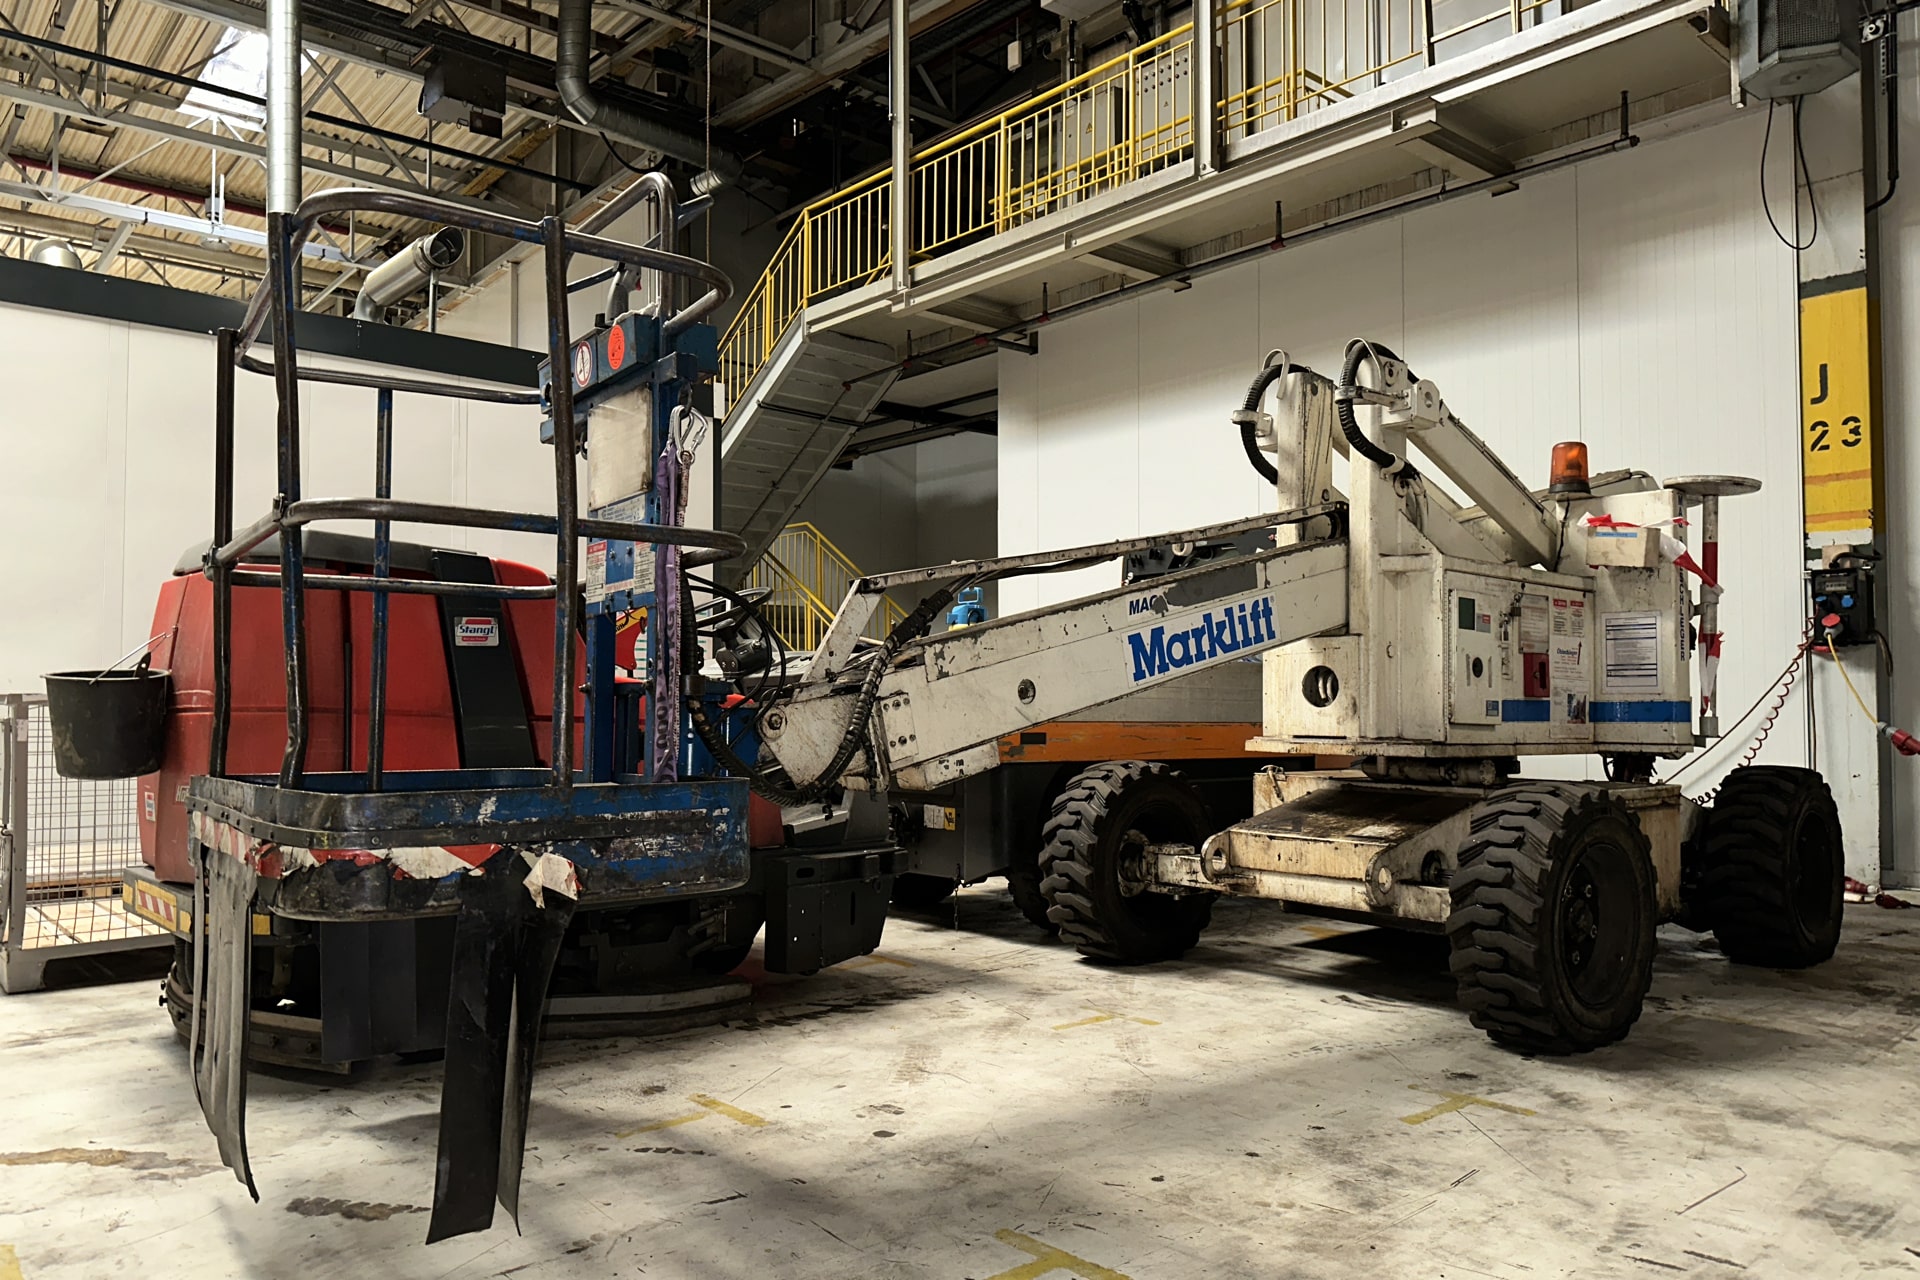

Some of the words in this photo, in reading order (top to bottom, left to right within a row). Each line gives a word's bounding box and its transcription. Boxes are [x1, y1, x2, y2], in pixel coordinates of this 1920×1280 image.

[1810, 363, 1829, 405] J
[459, 625, 495, 636] Stangl
[1127, 597, 1276, 682] Marklift
[656, 691, 669, 749] 1000
